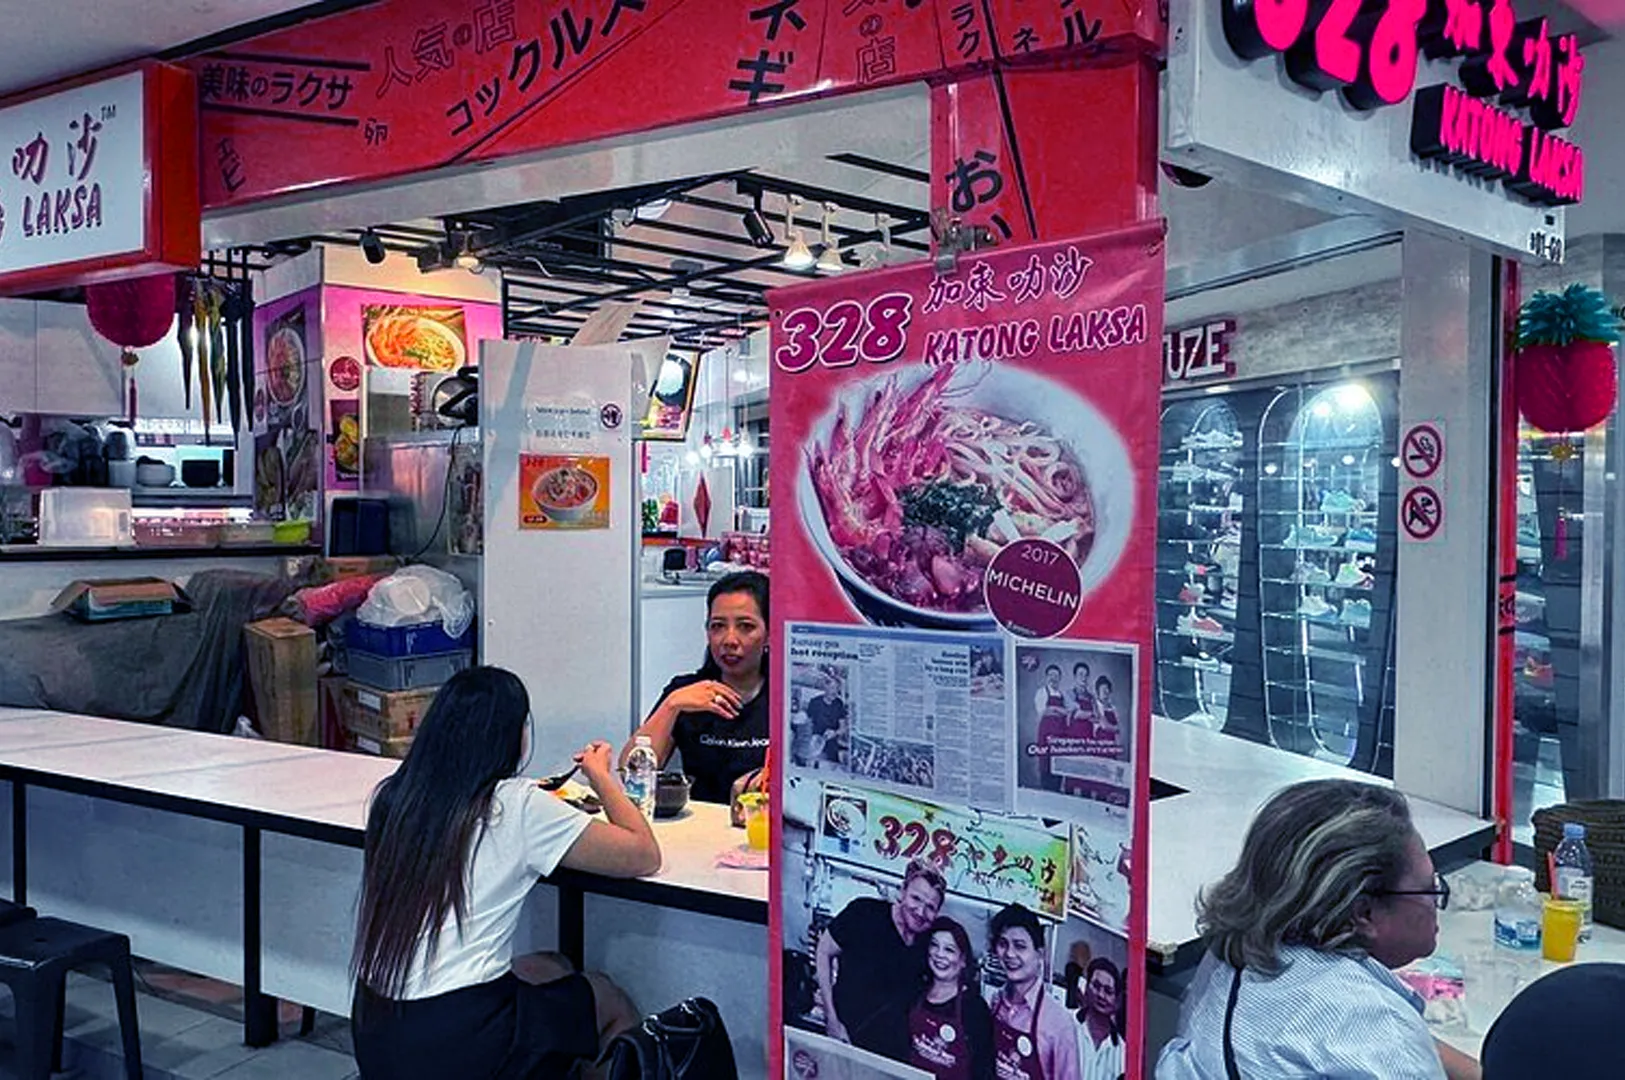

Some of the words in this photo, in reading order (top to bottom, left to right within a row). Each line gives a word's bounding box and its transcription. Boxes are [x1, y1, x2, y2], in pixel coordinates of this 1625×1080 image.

[203, 62, 354, 110] 美味のラクサ
[1440, 85, 1523, 177] KATONG
[1529, 126, 1584, 203] LAKSA
[22, 182, 103, 238] LAKSA
[775, 292, 913, 373] 328
[922, 319, 1040, 366] KATONG
[1046, 304, 1149, 353] LAKSA
[1020, 544, 1060, 566] 2017
[988, 568, 1079, 609] MICHELIN
[875, 815, 958, 874] 328
